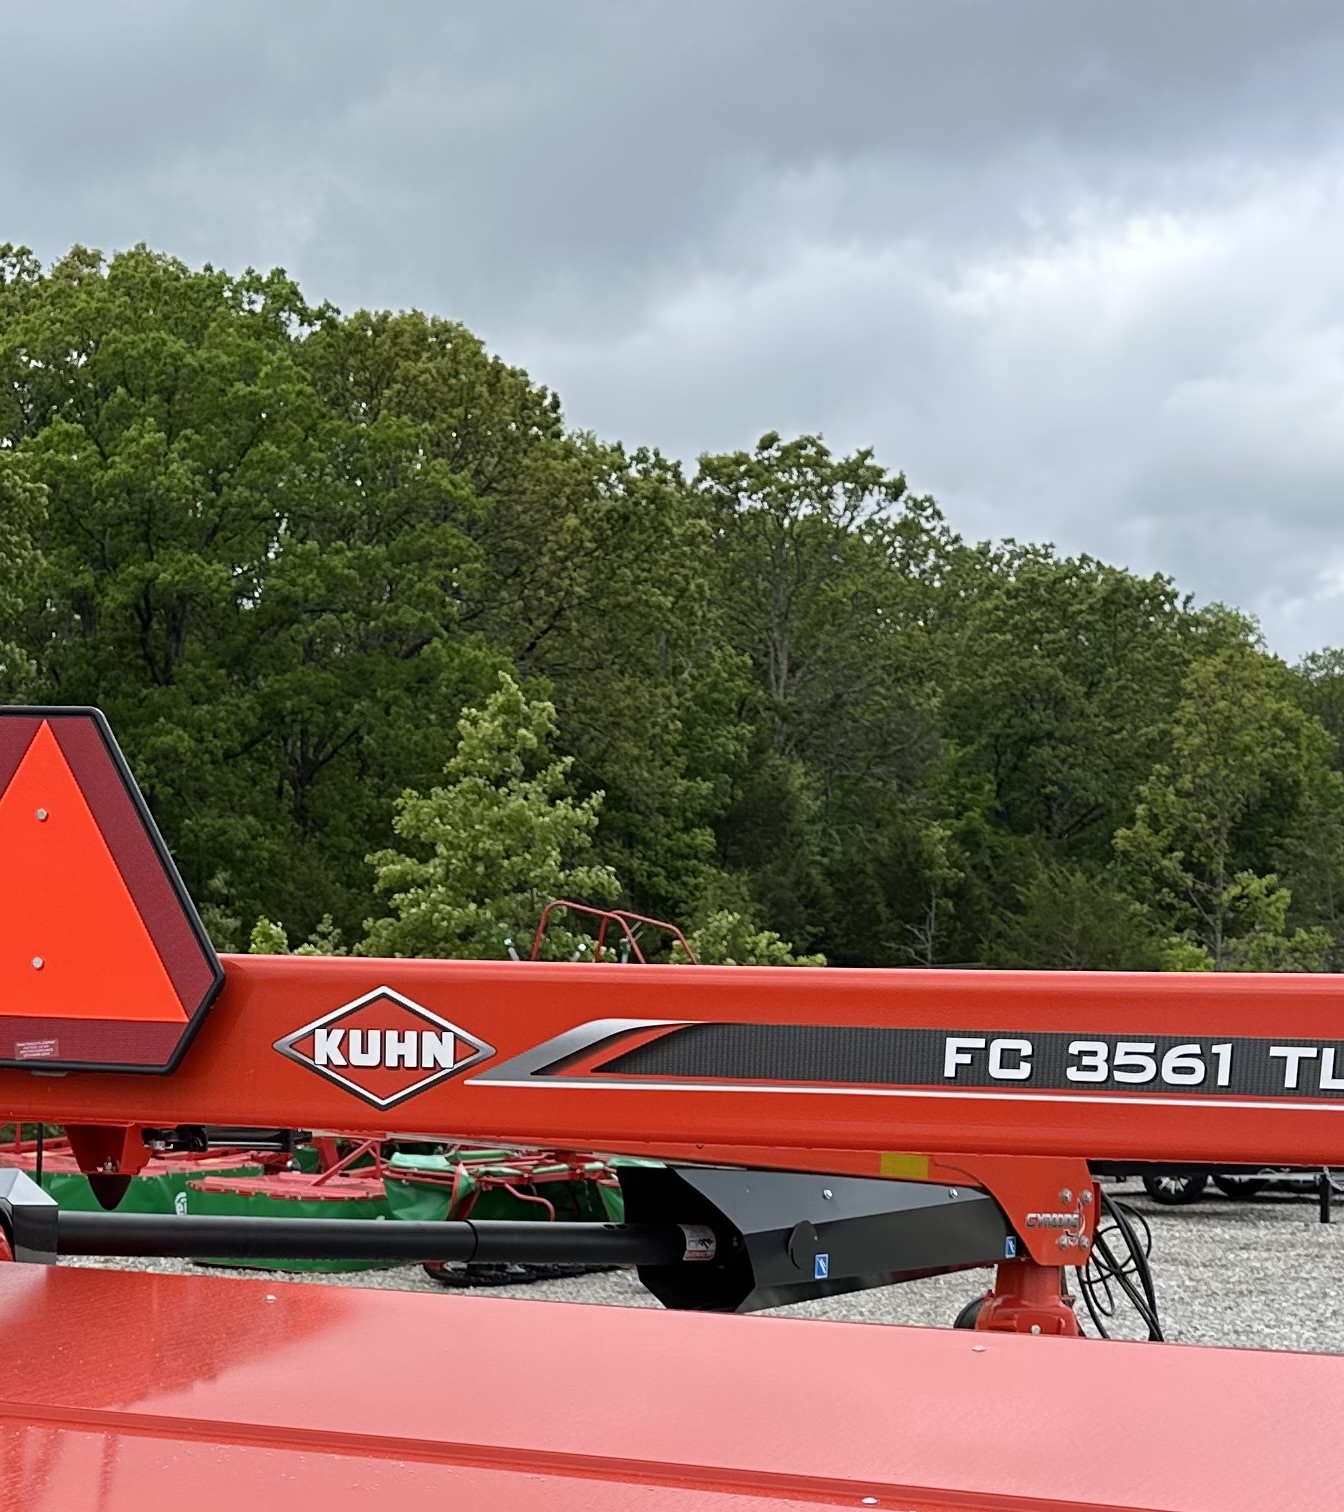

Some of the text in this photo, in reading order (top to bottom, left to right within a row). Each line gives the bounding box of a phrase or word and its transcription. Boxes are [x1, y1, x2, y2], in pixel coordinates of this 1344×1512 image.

[313, 1028, 454, 1068] KUHN
[943, 1036, 1034, 1081] FC
[1065, 1040, 1233, 1087] 3561
